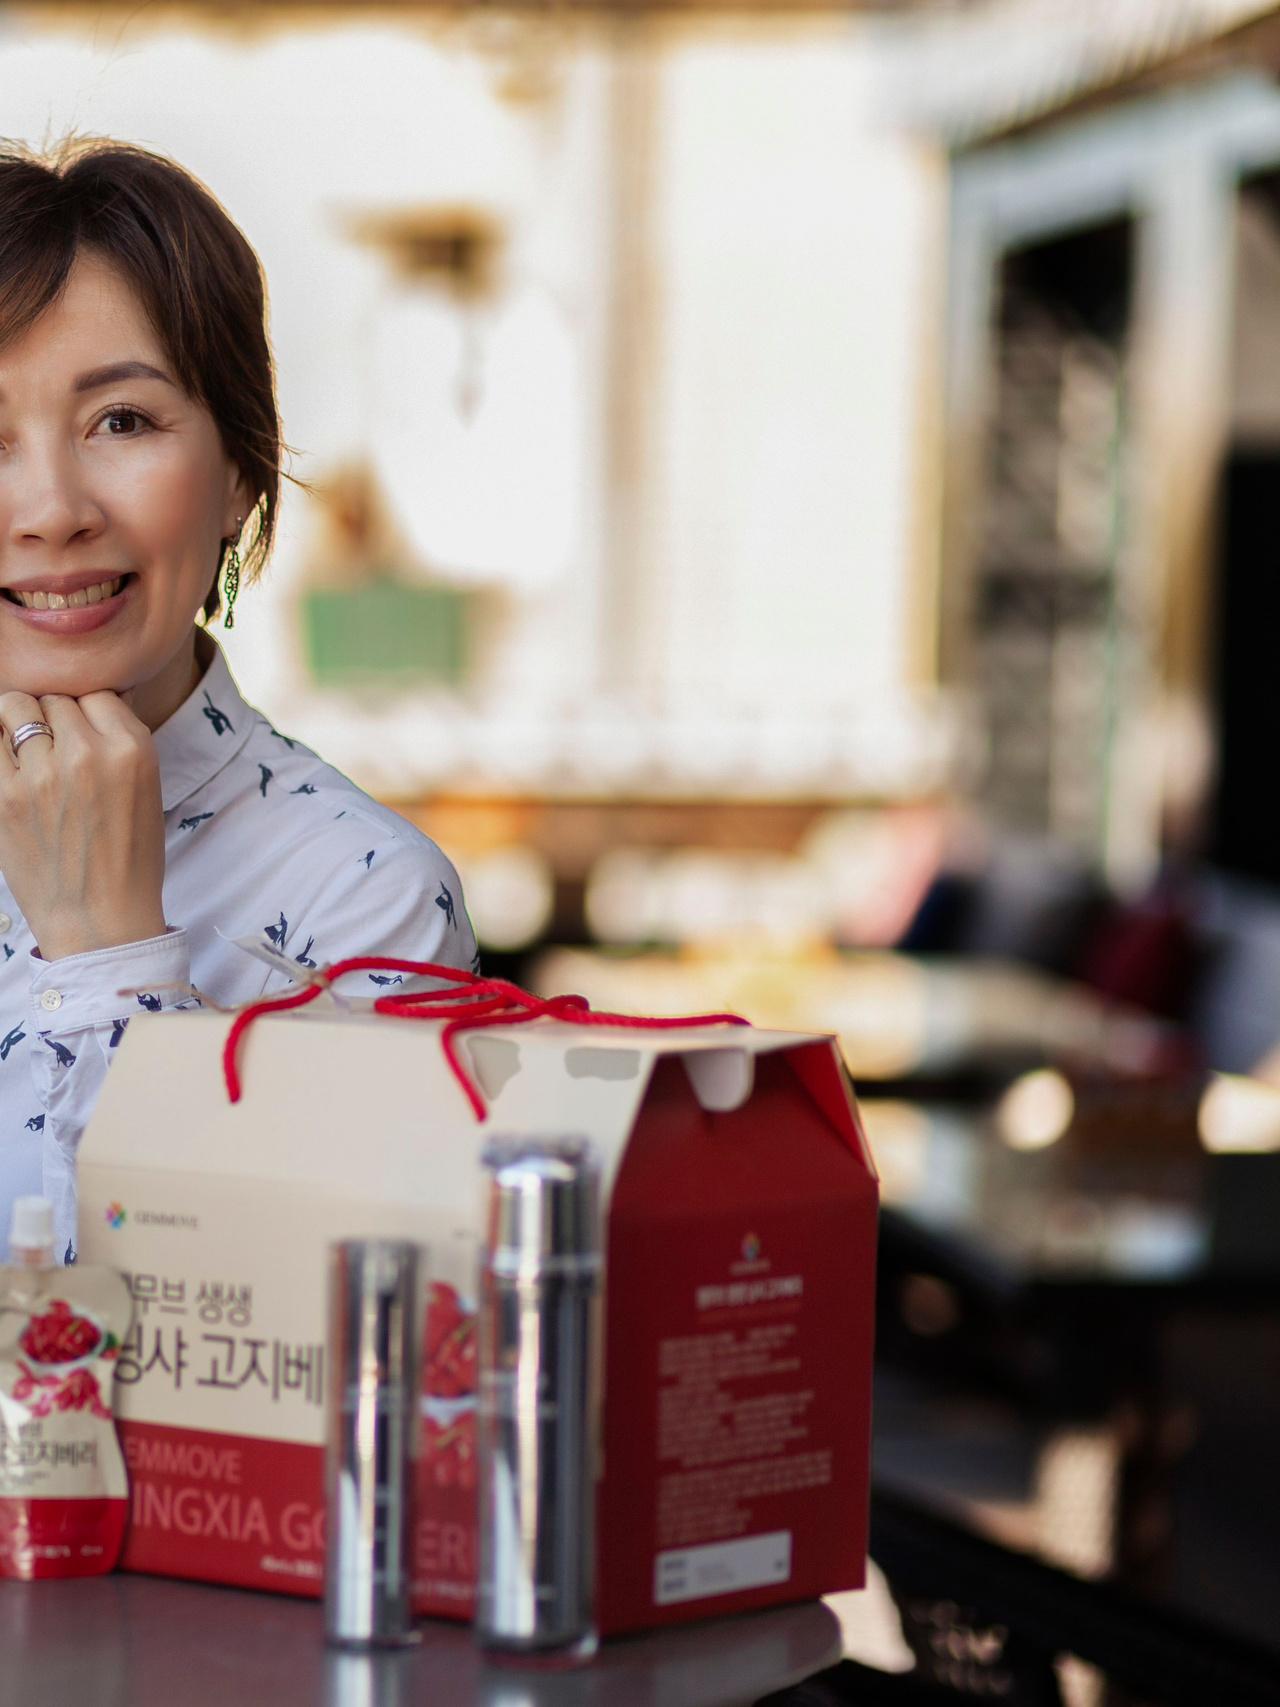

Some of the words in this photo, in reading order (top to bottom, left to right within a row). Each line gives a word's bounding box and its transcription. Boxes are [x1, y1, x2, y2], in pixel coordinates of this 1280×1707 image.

[122, 1272, 188, 1315] 무브
[195, 1280, 252, 1328] 생생
[195, 1330, 324, 1406] 고지베
[124, 1436, 243, 1484] EMMOVE
[132, 1483, 272, 1546] INGXIA
